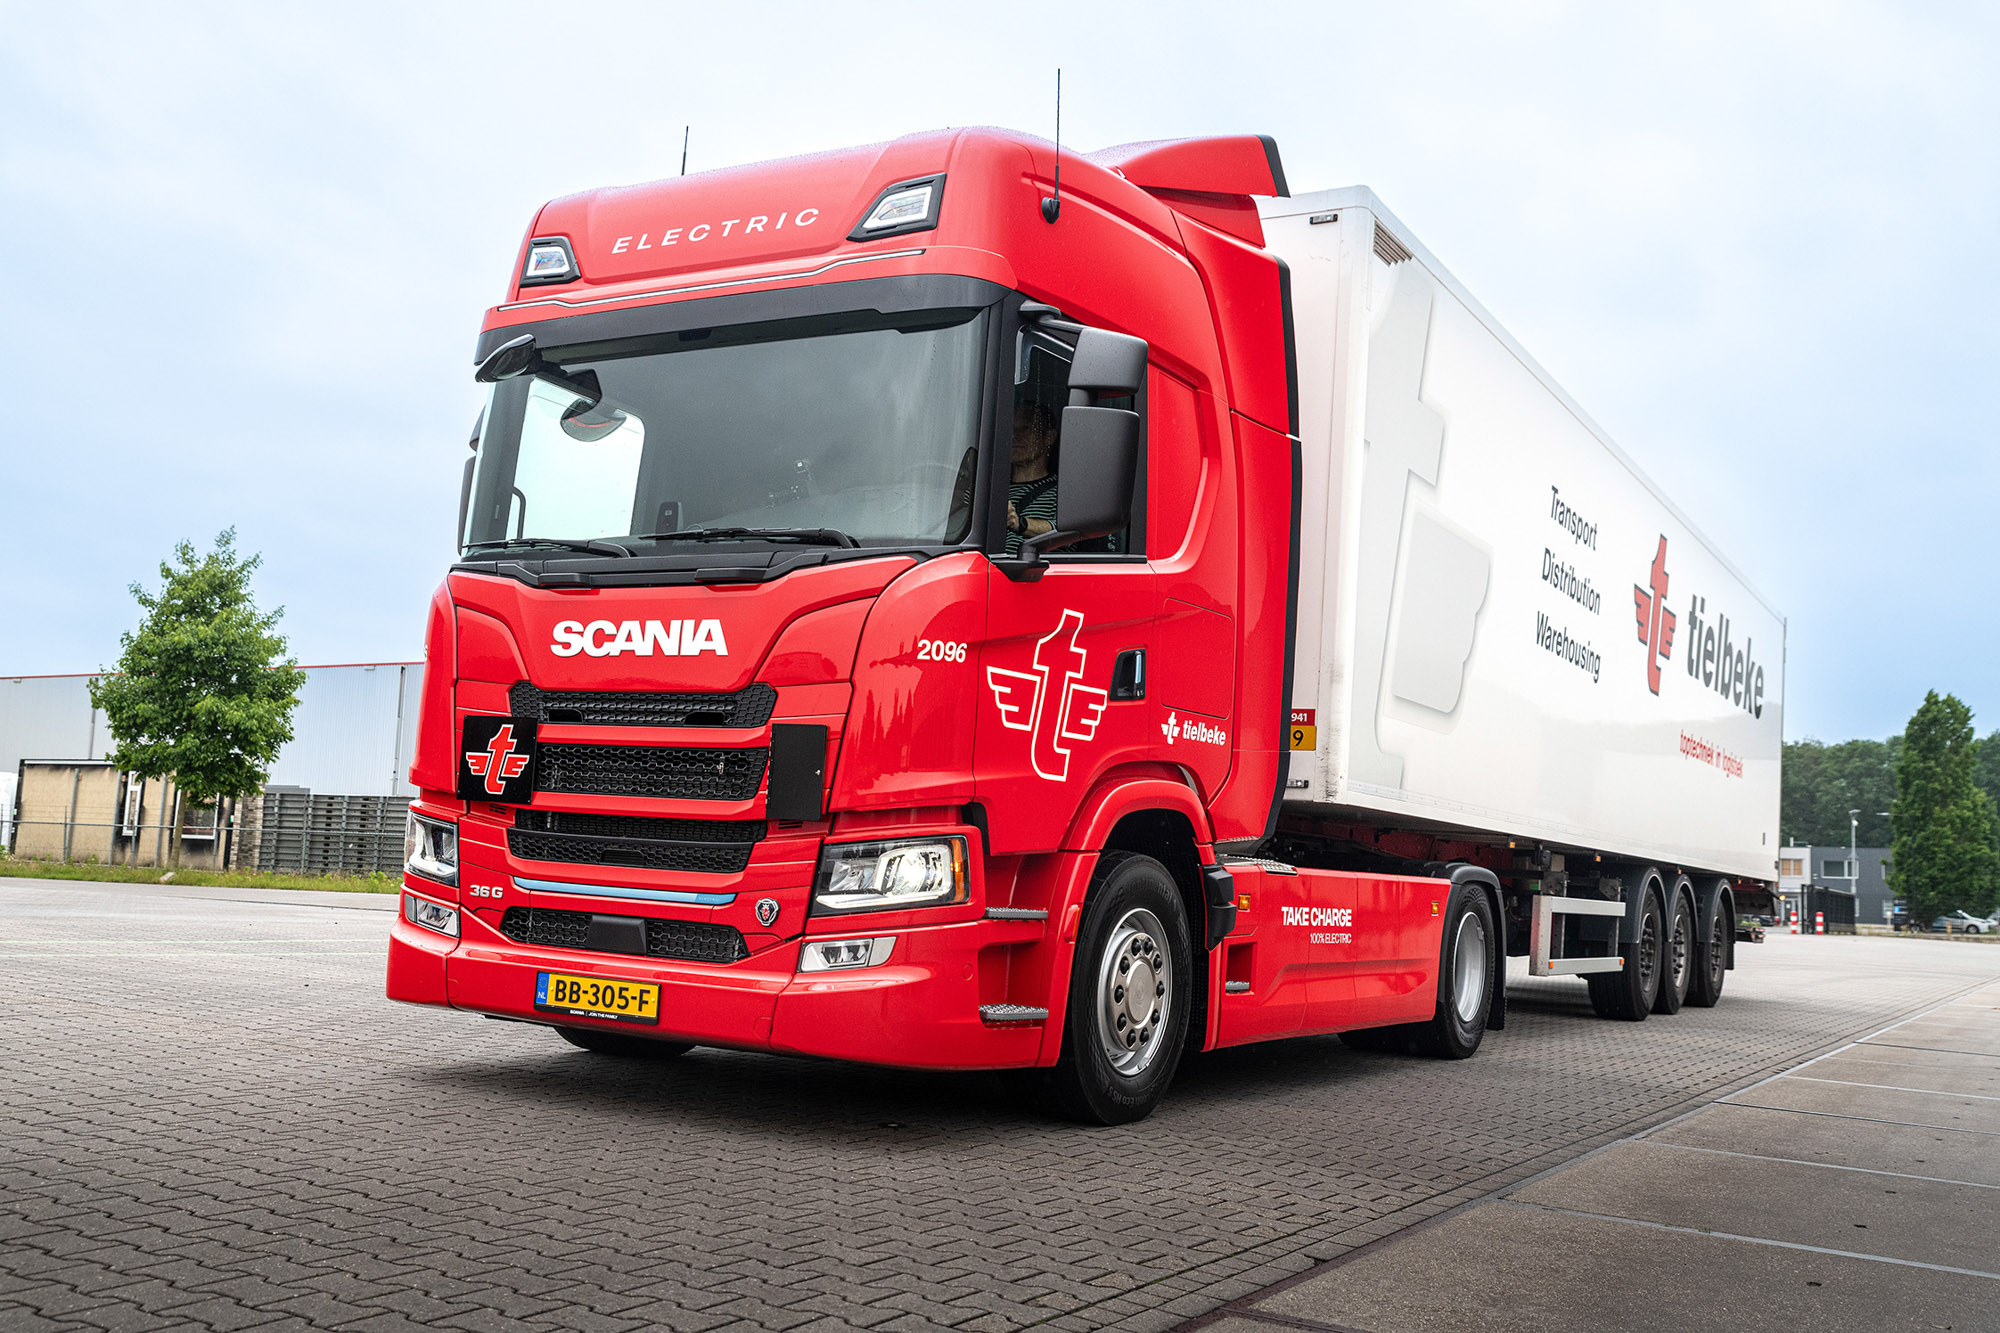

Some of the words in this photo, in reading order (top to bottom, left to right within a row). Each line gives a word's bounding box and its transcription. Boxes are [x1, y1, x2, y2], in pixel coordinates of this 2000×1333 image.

[611, 208, 819, 254] ELECTRIC
[1551, 485, 1597, 551] Transport
[1542, 547, 1600, 615] Distribution
[550, 619, 728, 657] SCANIA
[917, 639, 967, 663] 2096
[1536, 610, 1601, 684] Warehousing
[1687, 594, 1764, 719] tielbeke
[1183, 720, 1226, 746] tielbeke
[1291, 712, 1308, 722] 941
[1680, 729, 1714, 766] toptechniek
[1281, 906, 1309, 926] TAKE
[1310, 907, 1352, 927] CHARGE
[1310, 933, 1324, 944] 100%
[1325, 933, 1352, 944] ELECTRIC
[537, 991, 546, 999] NL
[555, 979, 650, 1012] BB-305-F
